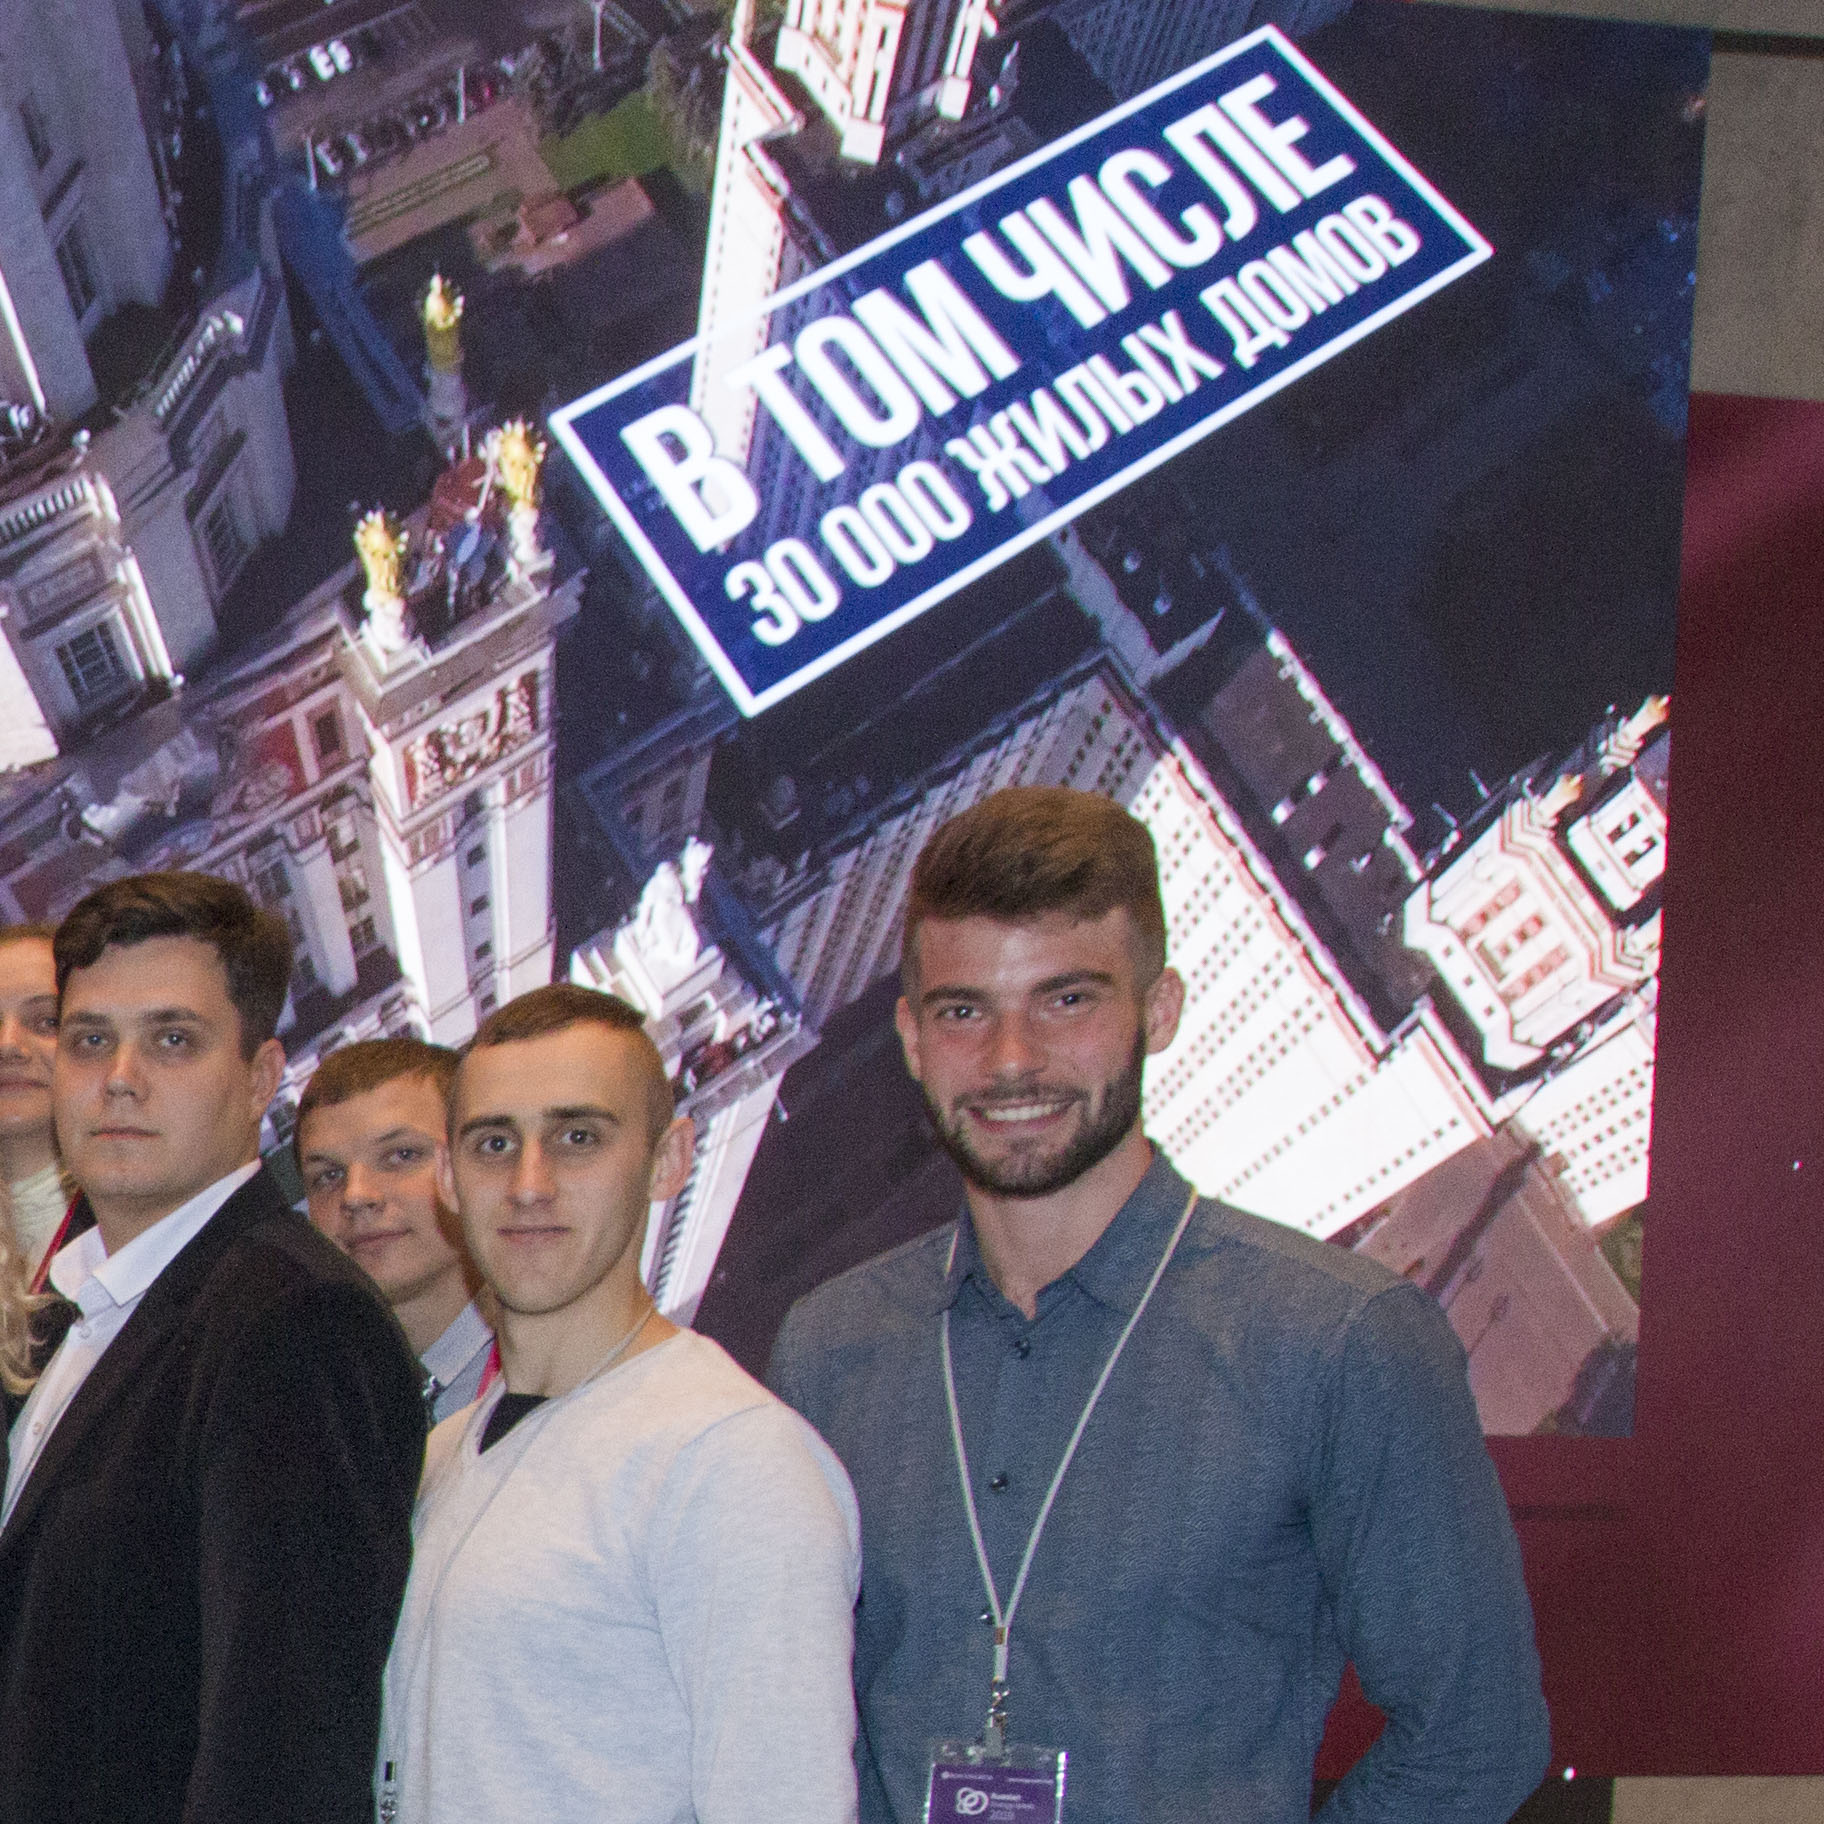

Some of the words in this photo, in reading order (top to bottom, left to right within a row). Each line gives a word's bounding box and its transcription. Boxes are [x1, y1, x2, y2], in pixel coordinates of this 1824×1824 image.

[621, 405, 758, 551] В
[724, 260, 1021, 482] ТОМ
[964, 75, 1355, 329] ЧИСЛЕ
[724, 539, 841, 647] 30
[820, 459, 972, 588] 000
[946, 311, 1224, 514] ЖИЛЫХ
[1200, 194, 1420, 368] ДОМОВ
